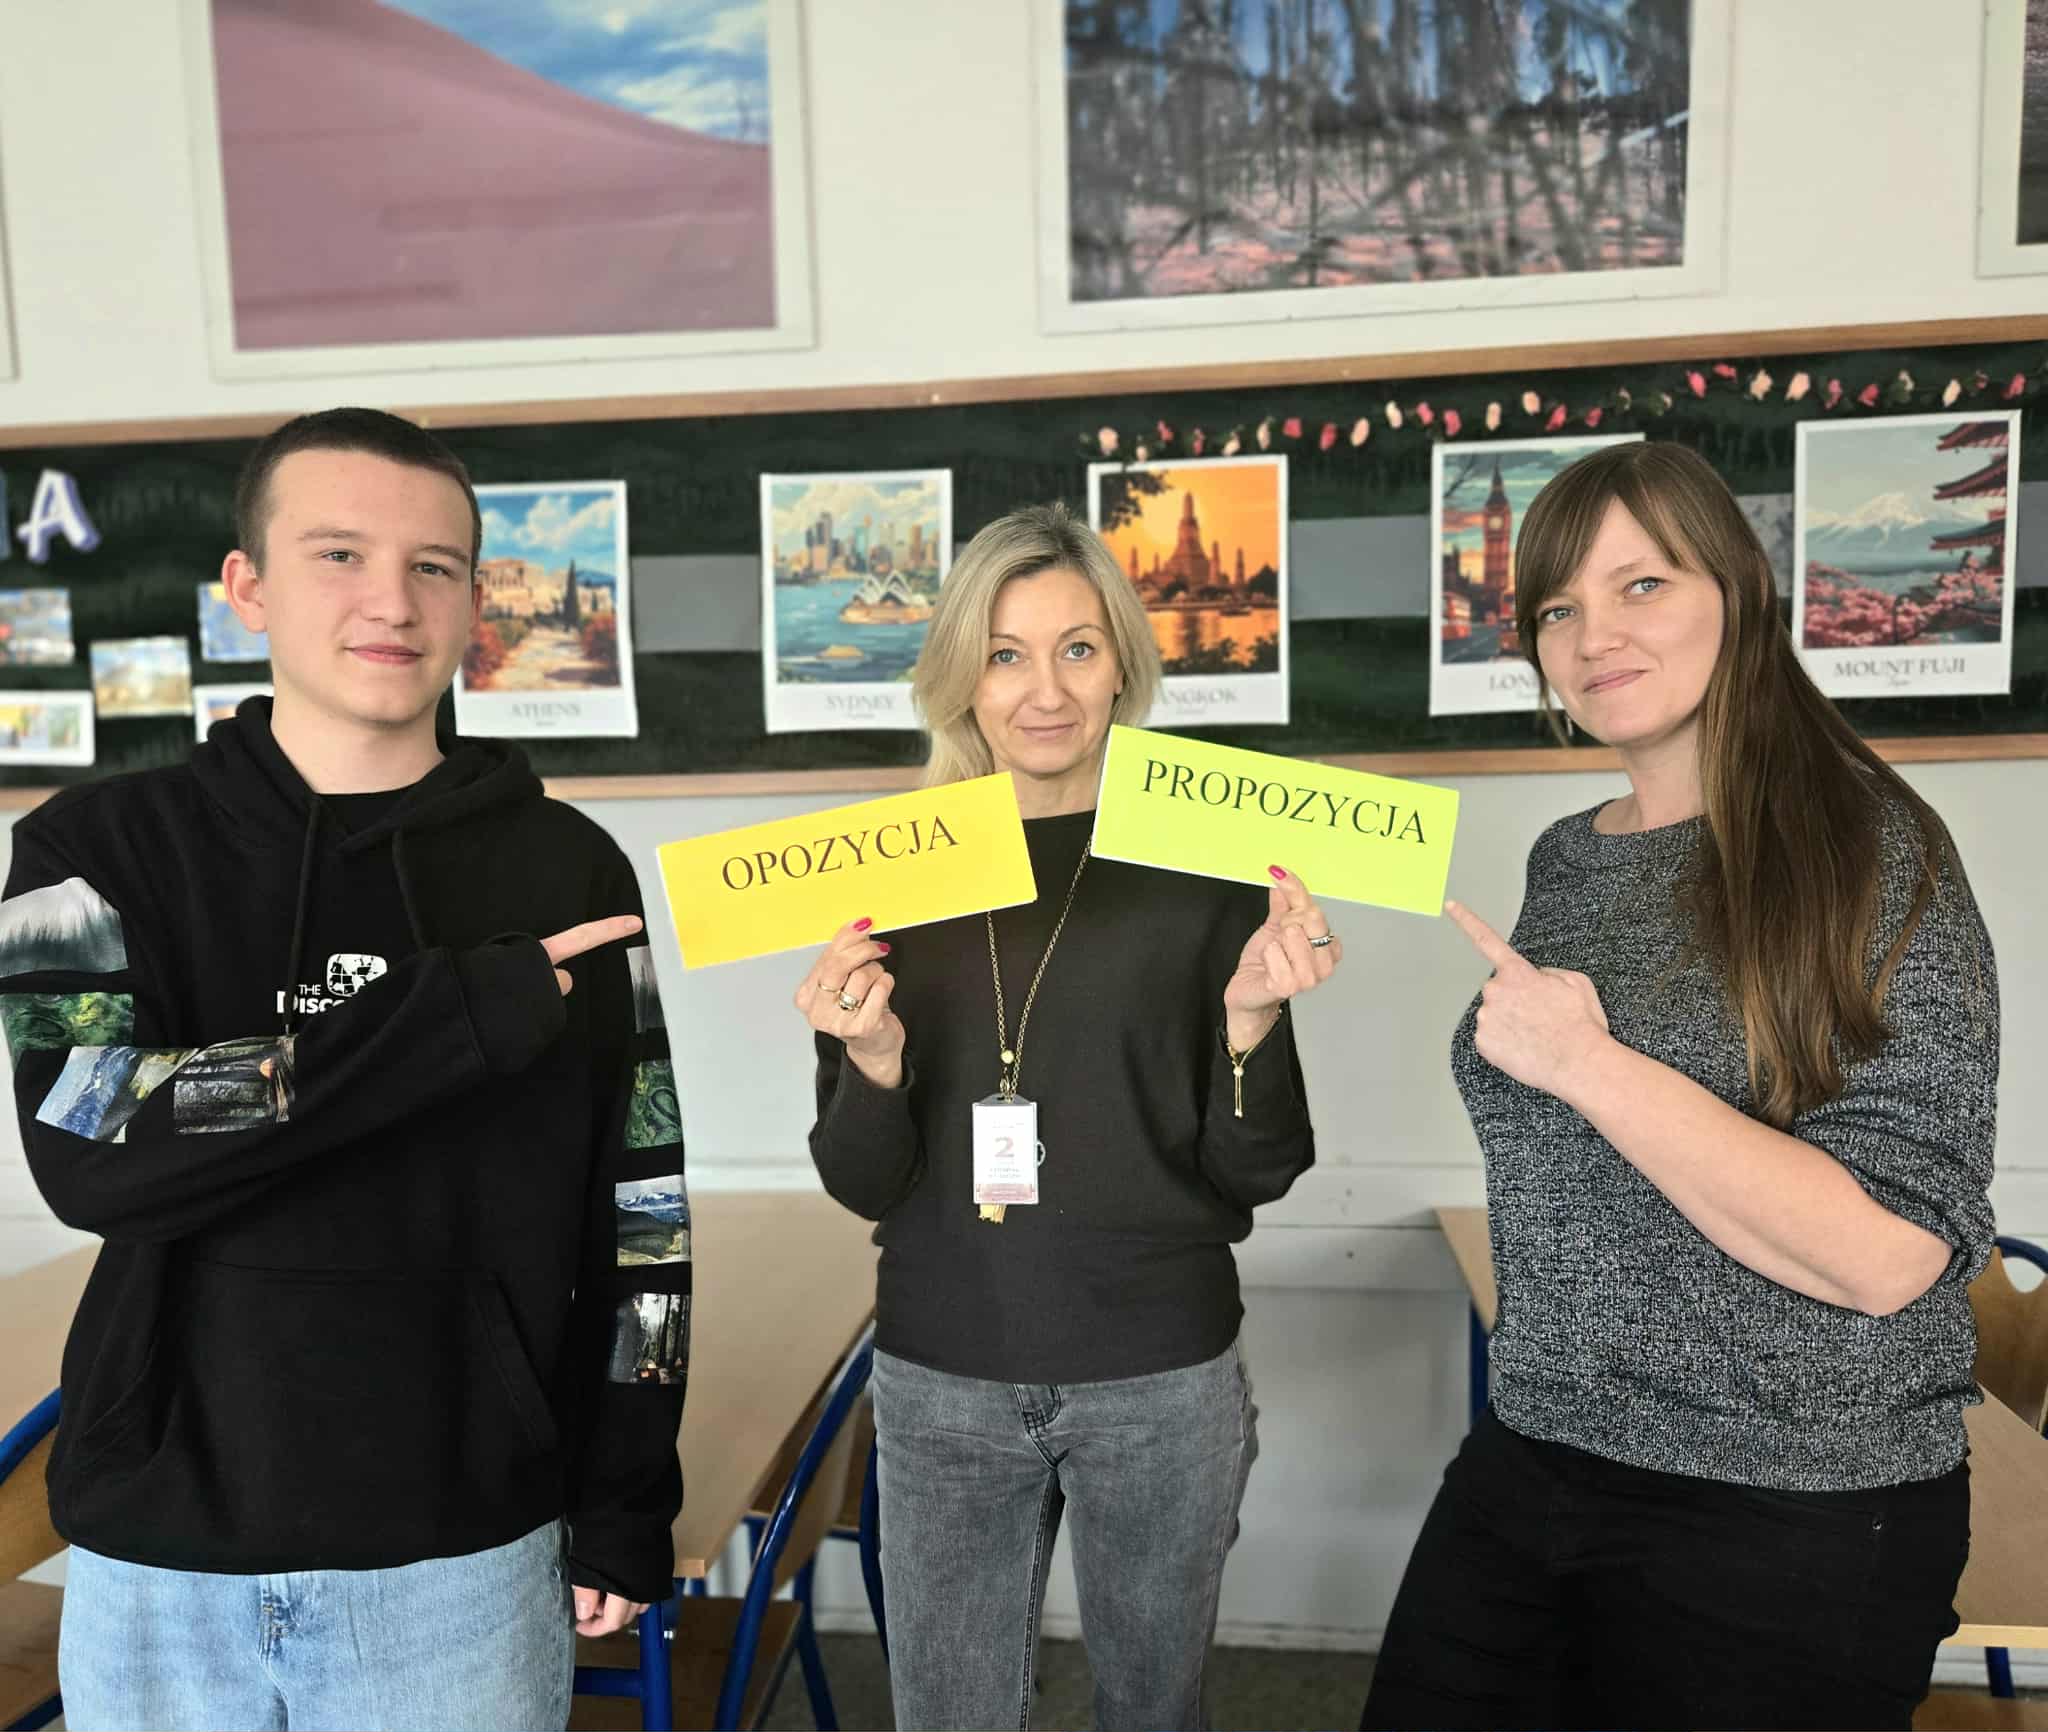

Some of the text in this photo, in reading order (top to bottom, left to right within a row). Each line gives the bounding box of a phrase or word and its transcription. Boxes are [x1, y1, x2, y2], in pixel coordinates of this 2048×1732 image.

[1833, 656, 1966, 677] MOUNT FUJI
[1489, 673, 1541, 692] LON
[823, 694, 896, 712] SYDNEY
[1153, 687, 1239, 705] ANGKOK
[1140, 759, 1426, 844] PROPOZYCJA
[722, 816, 960, 890] OPOZYCJA
[298, 984, 321, 996] THE
[994, 1136, 1016, 1158] 2
